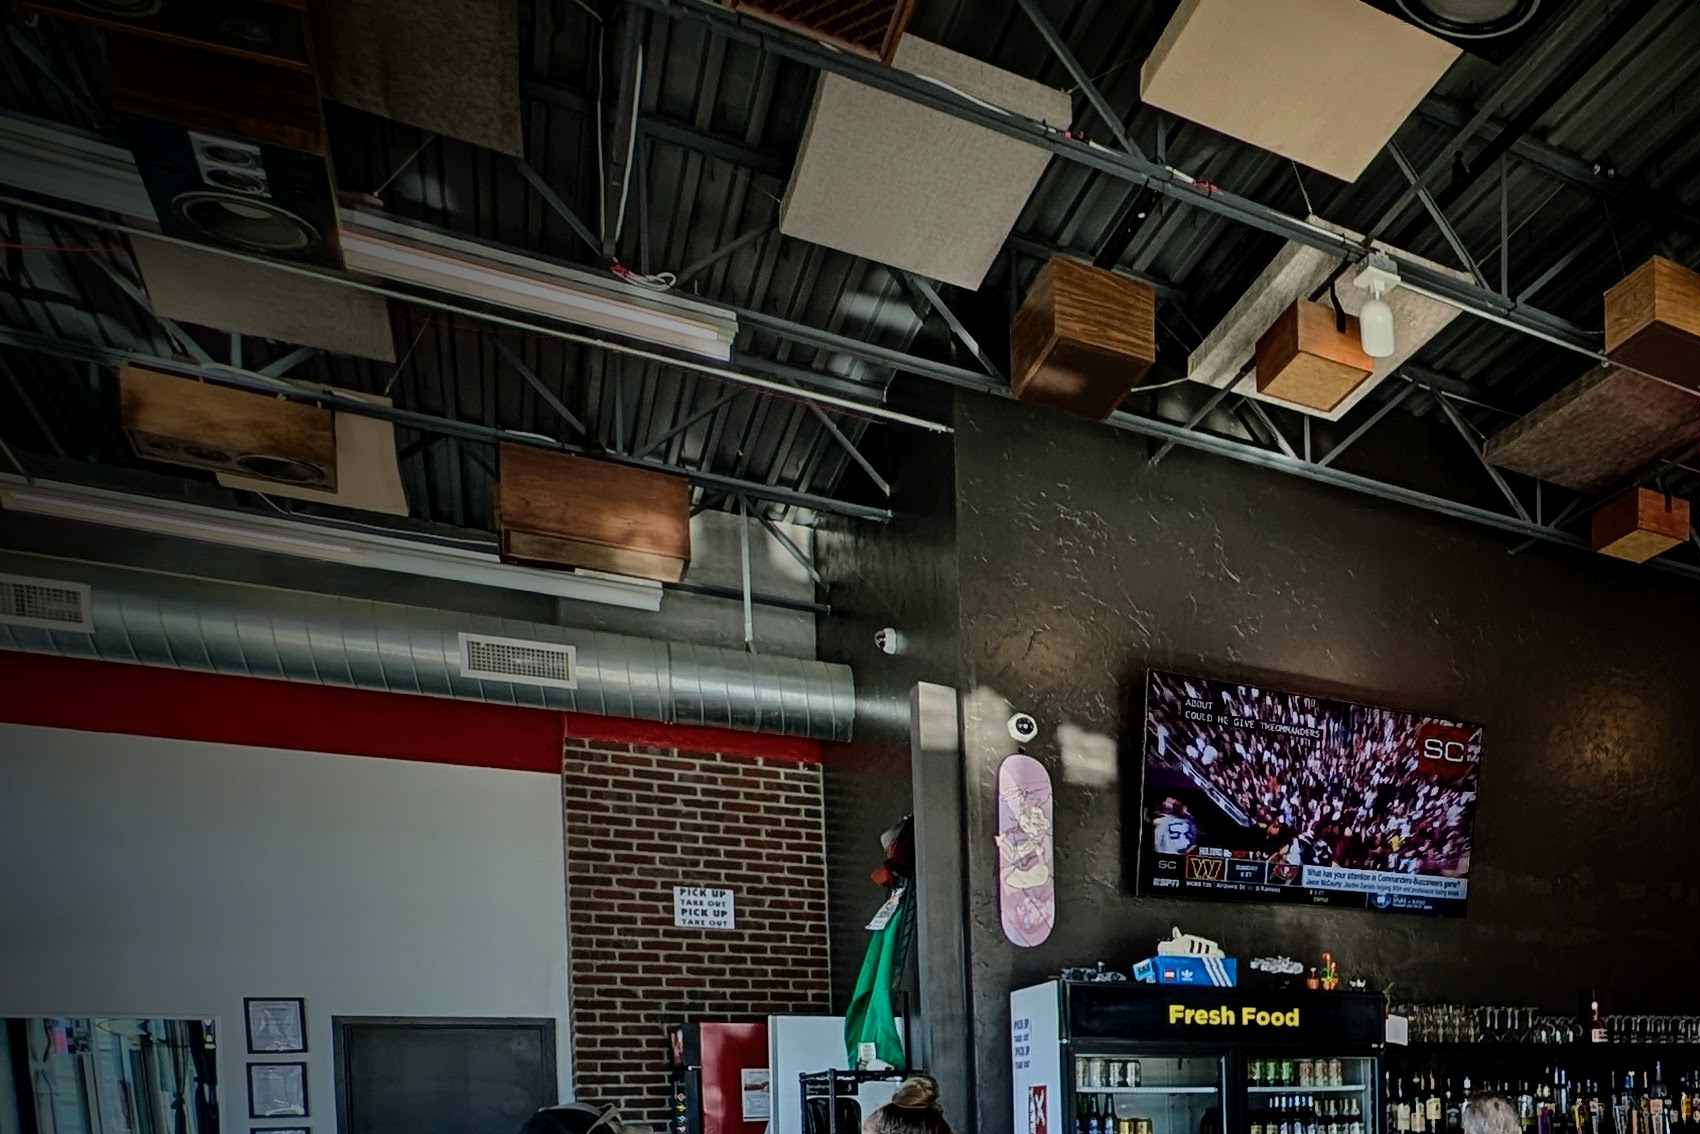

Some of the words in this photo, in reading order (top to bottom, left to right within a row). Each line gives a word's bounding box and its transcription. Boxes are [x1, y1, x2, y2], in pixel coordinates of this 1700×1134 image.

[1185, 699, 1213, 710] ABOUT
[1185, 711, 1212, 722] COULD
[1217, 716, 1228, 724] HE
[1234, 718, 1254, 729] GIVE
[1424, 738, 1464, 762] SC
[1308, 868, 1322, 878] What
[1323, 870, 1332, 878] has
[1334, 872, 1346, 881] your
[1347, 872, 1370, 881] attention
[1444, 880, 1460, 889] game?
[680, 888, 706, 897] PICK
[712, 890, 726, 898] UP
[681, 908, 708, 917] PICK
[713, 910, 728, 918] UP
[1168, 1004, 1236, 1026] Fresh
[1242, 1007, 1300, 1027] Food
